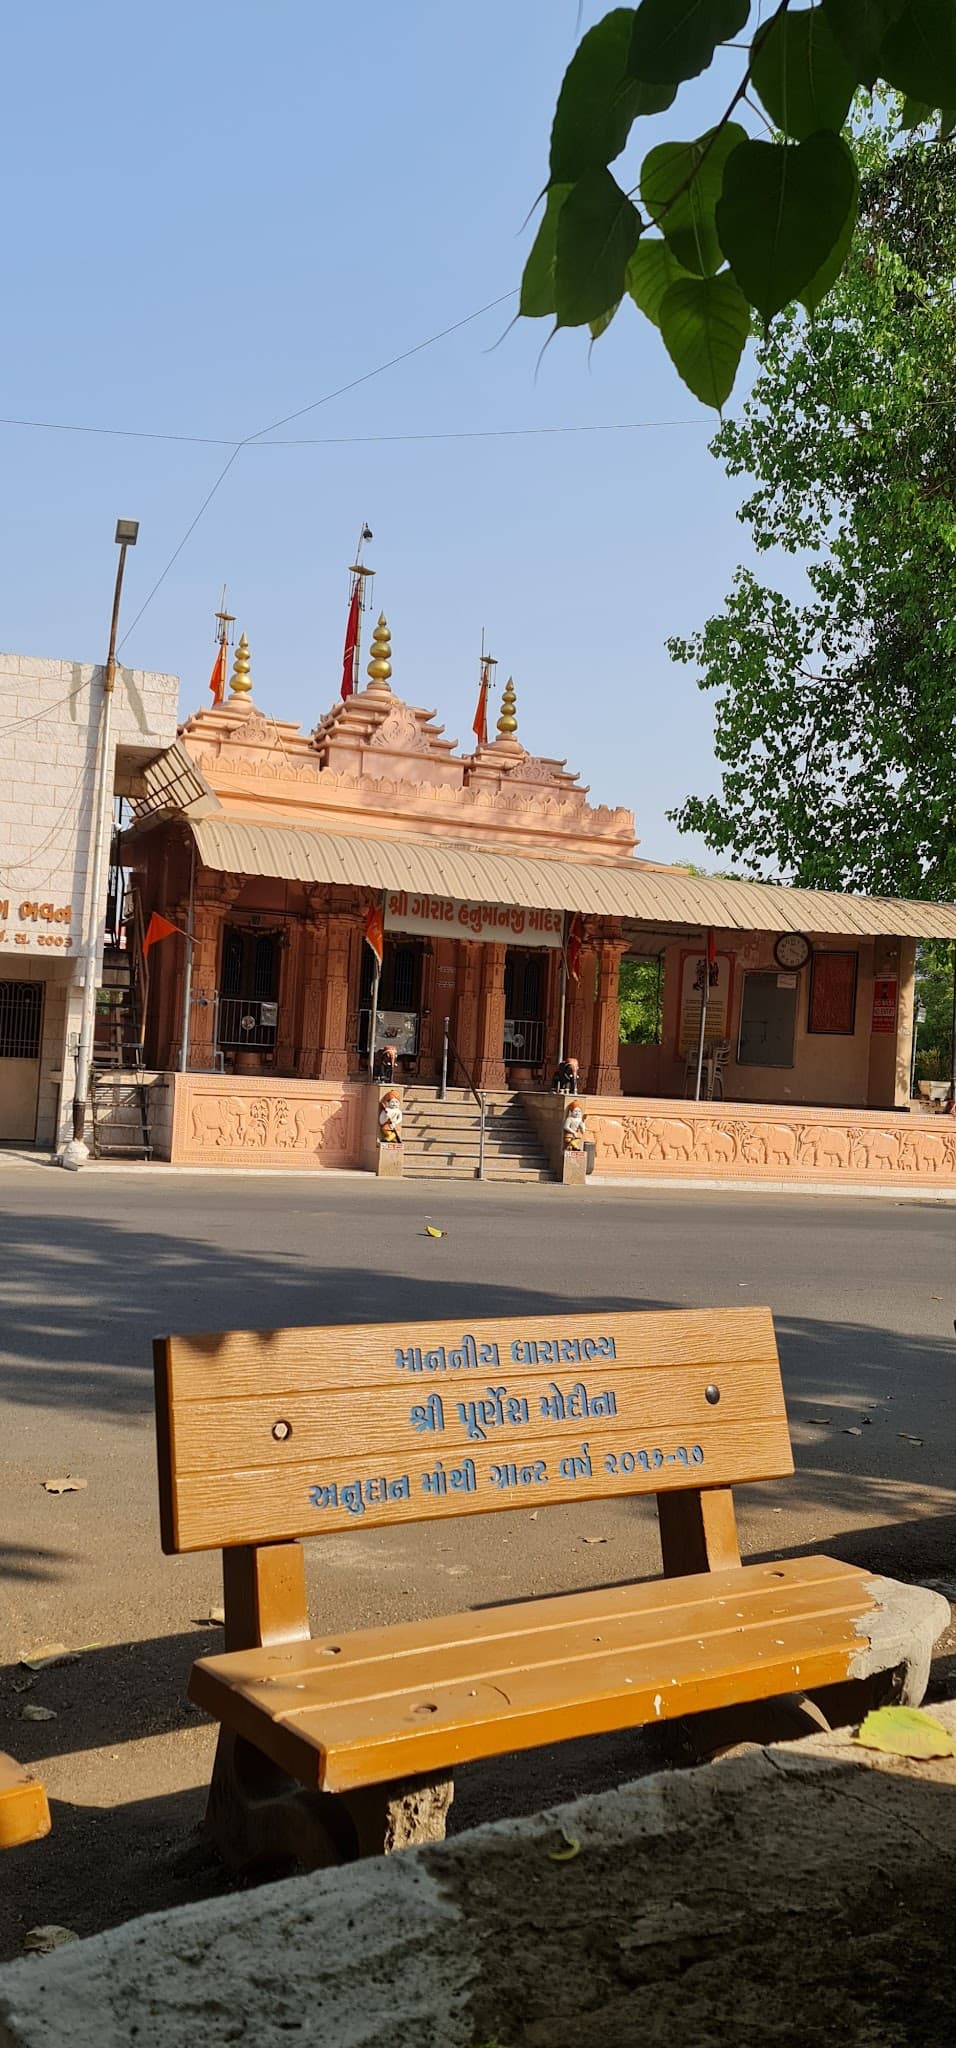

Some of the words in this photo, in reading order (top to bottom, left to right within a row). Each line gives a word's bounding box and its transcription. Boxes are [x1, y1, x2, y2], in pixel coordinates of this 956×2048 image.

[19, 901, 72, 924] ભવન
[389, 891, 408, 916] શ્રી
[458, 903, 525, 933] હનુમાનજી
[529, 908, 562, 933] મદિર
[37, 935, 73, 948] ૨૦૦૩
[394, 1334, 500, 1372] માનનીય
[511, 1336, 617, 1365] ધારાસભ્ય
[409, 1394, 445, 1433] શ્રી
[456, 1386, 529, 1440] પૂર્ણેશ
[540, 1382, 618, 1422] મોદીના
[308, 1474, 411, 1516] અનુદાન
[421, 1458, 478, 1496] માંથી
[488, 1460, 549, 1489] ગ્રાન્ટ
[559, 1442, 593, 1481] વર્ષ
[604, 1445, 704, 1475] ૨૦૧૬-૧૭
